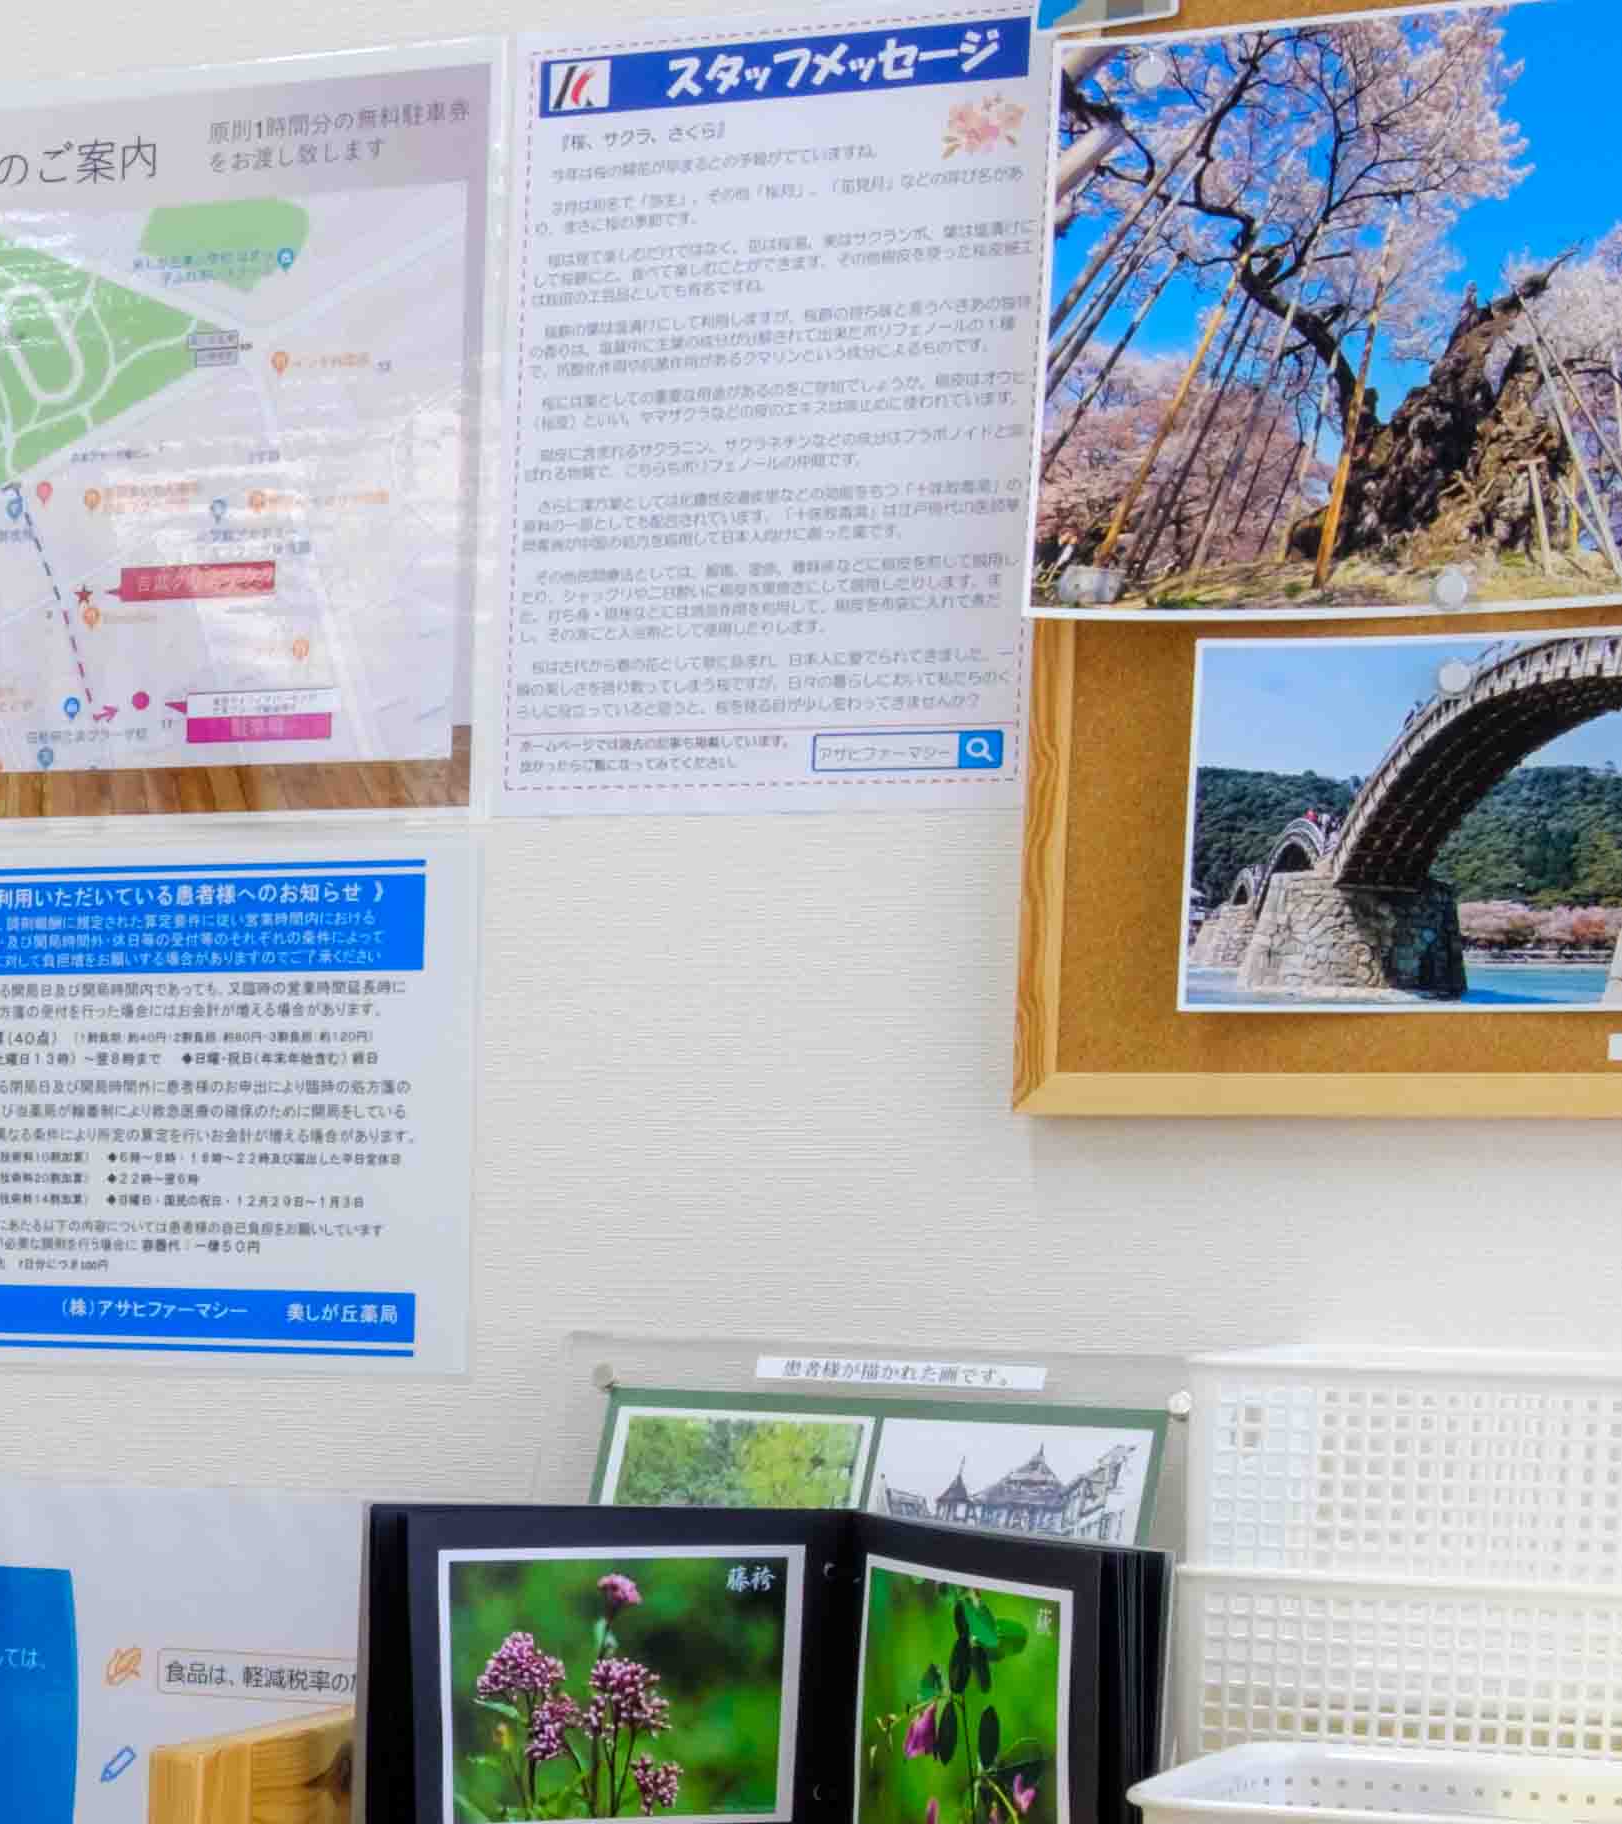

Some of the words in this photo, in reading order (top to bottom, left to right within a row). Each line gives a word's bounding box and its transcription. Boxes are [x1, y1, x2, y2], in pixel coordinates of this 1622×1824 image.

[667, 27, 1000, 98] スタッフメッセージ
[206, 98, 471, 164] 原則1時間分の無料駐車券
[207, 138, 387, 190] をお渡し致します
[818, 743, 952, 764] アサヒファーマシー
[285, 1301, 399, 1326] 美しが丘薬局
[783, 1368, 1014, 1399] 患者様が描かれた画です。
